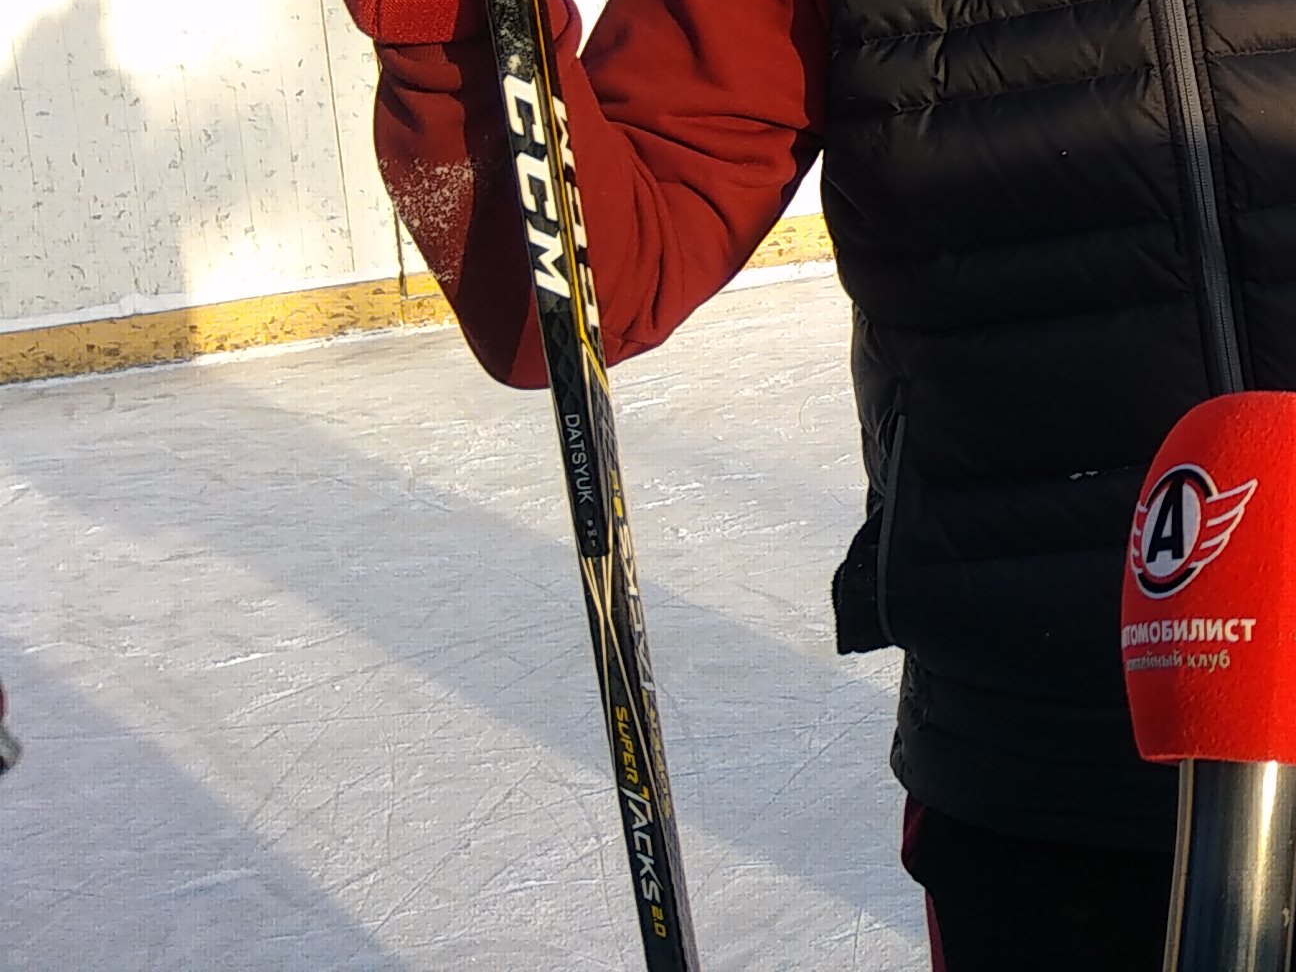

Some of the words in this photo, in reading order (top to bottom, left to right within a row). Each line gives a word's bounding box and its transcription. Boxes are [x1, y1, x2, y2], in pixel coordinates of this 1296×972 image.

[503, 74, 571, 298] CCM
[564, 413, 594, 505] DATSYUK
[1121, 618, 1257, 649] ТОМОБИЛИСТ
[1186, 649, 1231, 674] клуб
[615, 706, 639, 785] SUPER
[619, 785, 664, 904] TACKS
